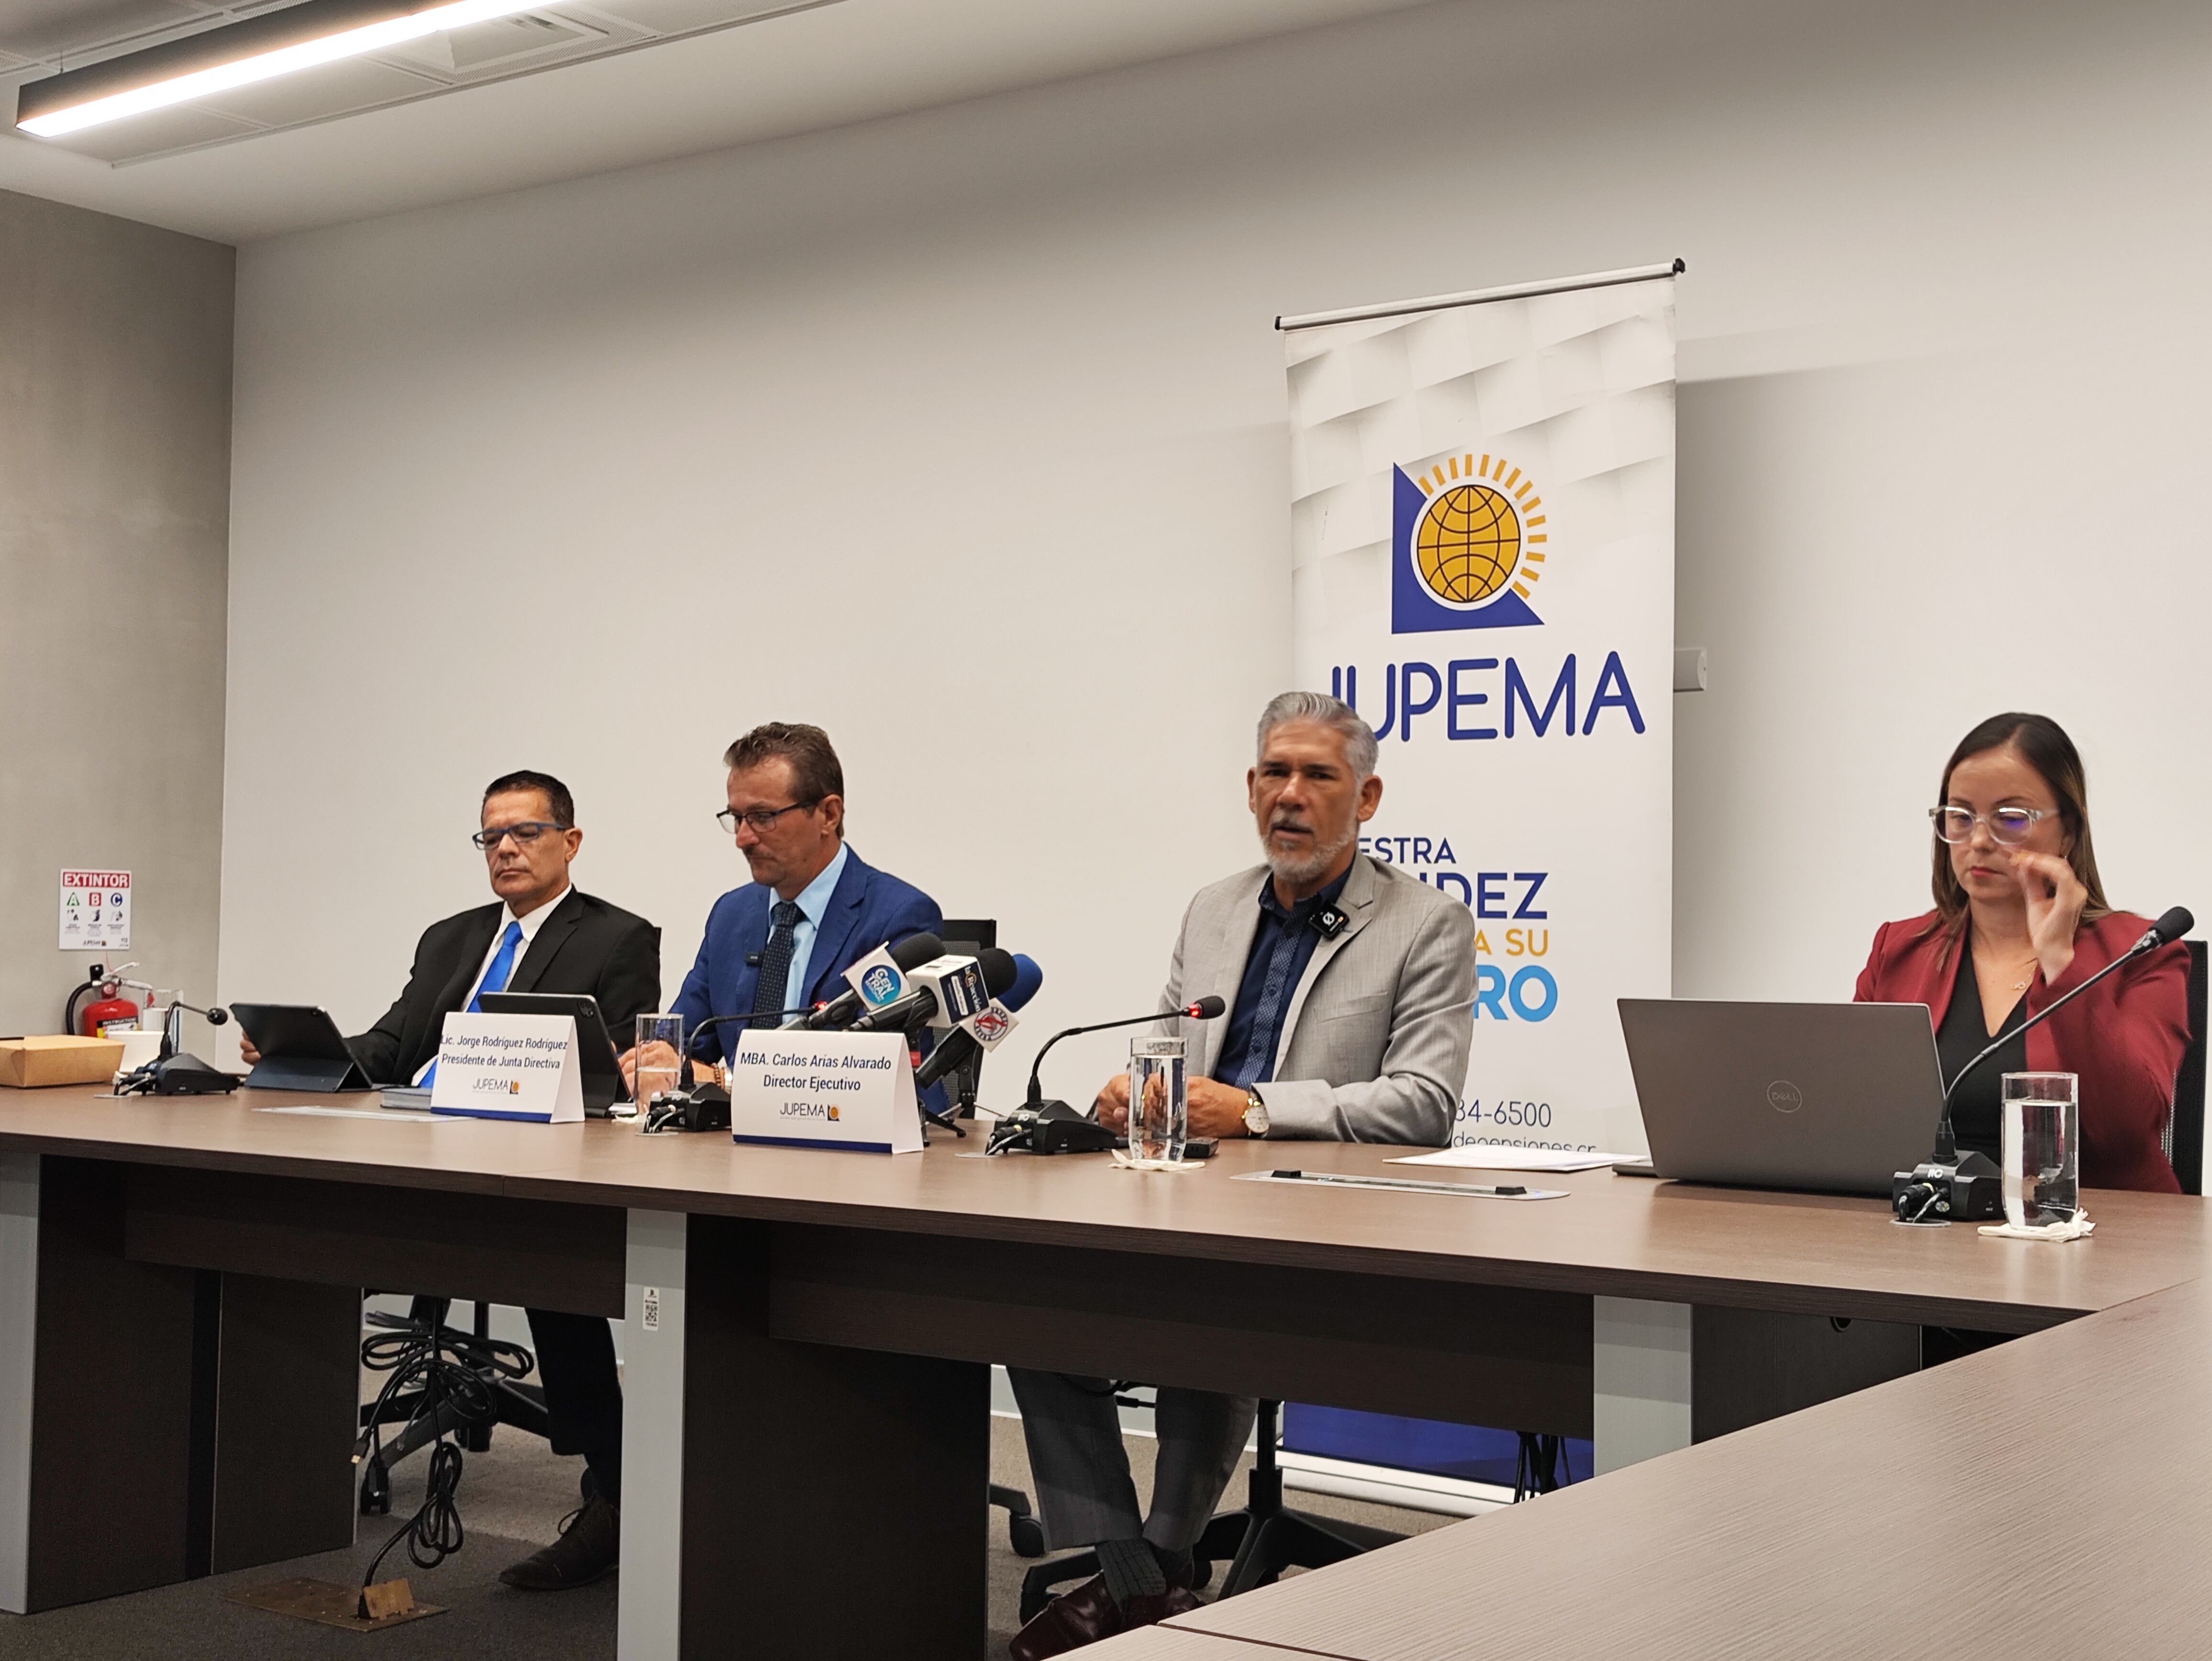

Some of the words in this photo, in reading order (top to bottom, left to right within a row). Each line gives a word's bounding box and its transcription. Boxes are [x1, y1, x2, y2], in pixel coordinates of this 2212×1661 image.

[64, 873, 128, 887] EXTINTOR
[67, 893, 79, 906] A
[91, 894, 100, 906] B
[112, 893, 122, 906] C
[1505, 929, 1548, 956] SU
[457, 1035, 480, 1049] Jorge
[483, 1036, 523, 1050] Rodríguez
[526, 1038, 568, 1052] Rodríguez
[442, 1053, 485, 1065] Presidente
[487, 1055, 497, 1066] de
[498, 1056, 522, 1067] Junta
[524, 1057, 560, 1069] Directiva
[740, 1052, 769, 1065] MBA.
[773, 1053, 807, 1066] Carlos
[809, 1054, 839, 1068] Arias
[841, 1055, 891, 1070] Alvarado
[473, 1078, 509, 1090] JUPEMA
[763, 1074, 807, 1088] Director
[810, 1075, 861, 1092] Ejecutivo
[780, 1102, 825, 1117] JUPEMA
